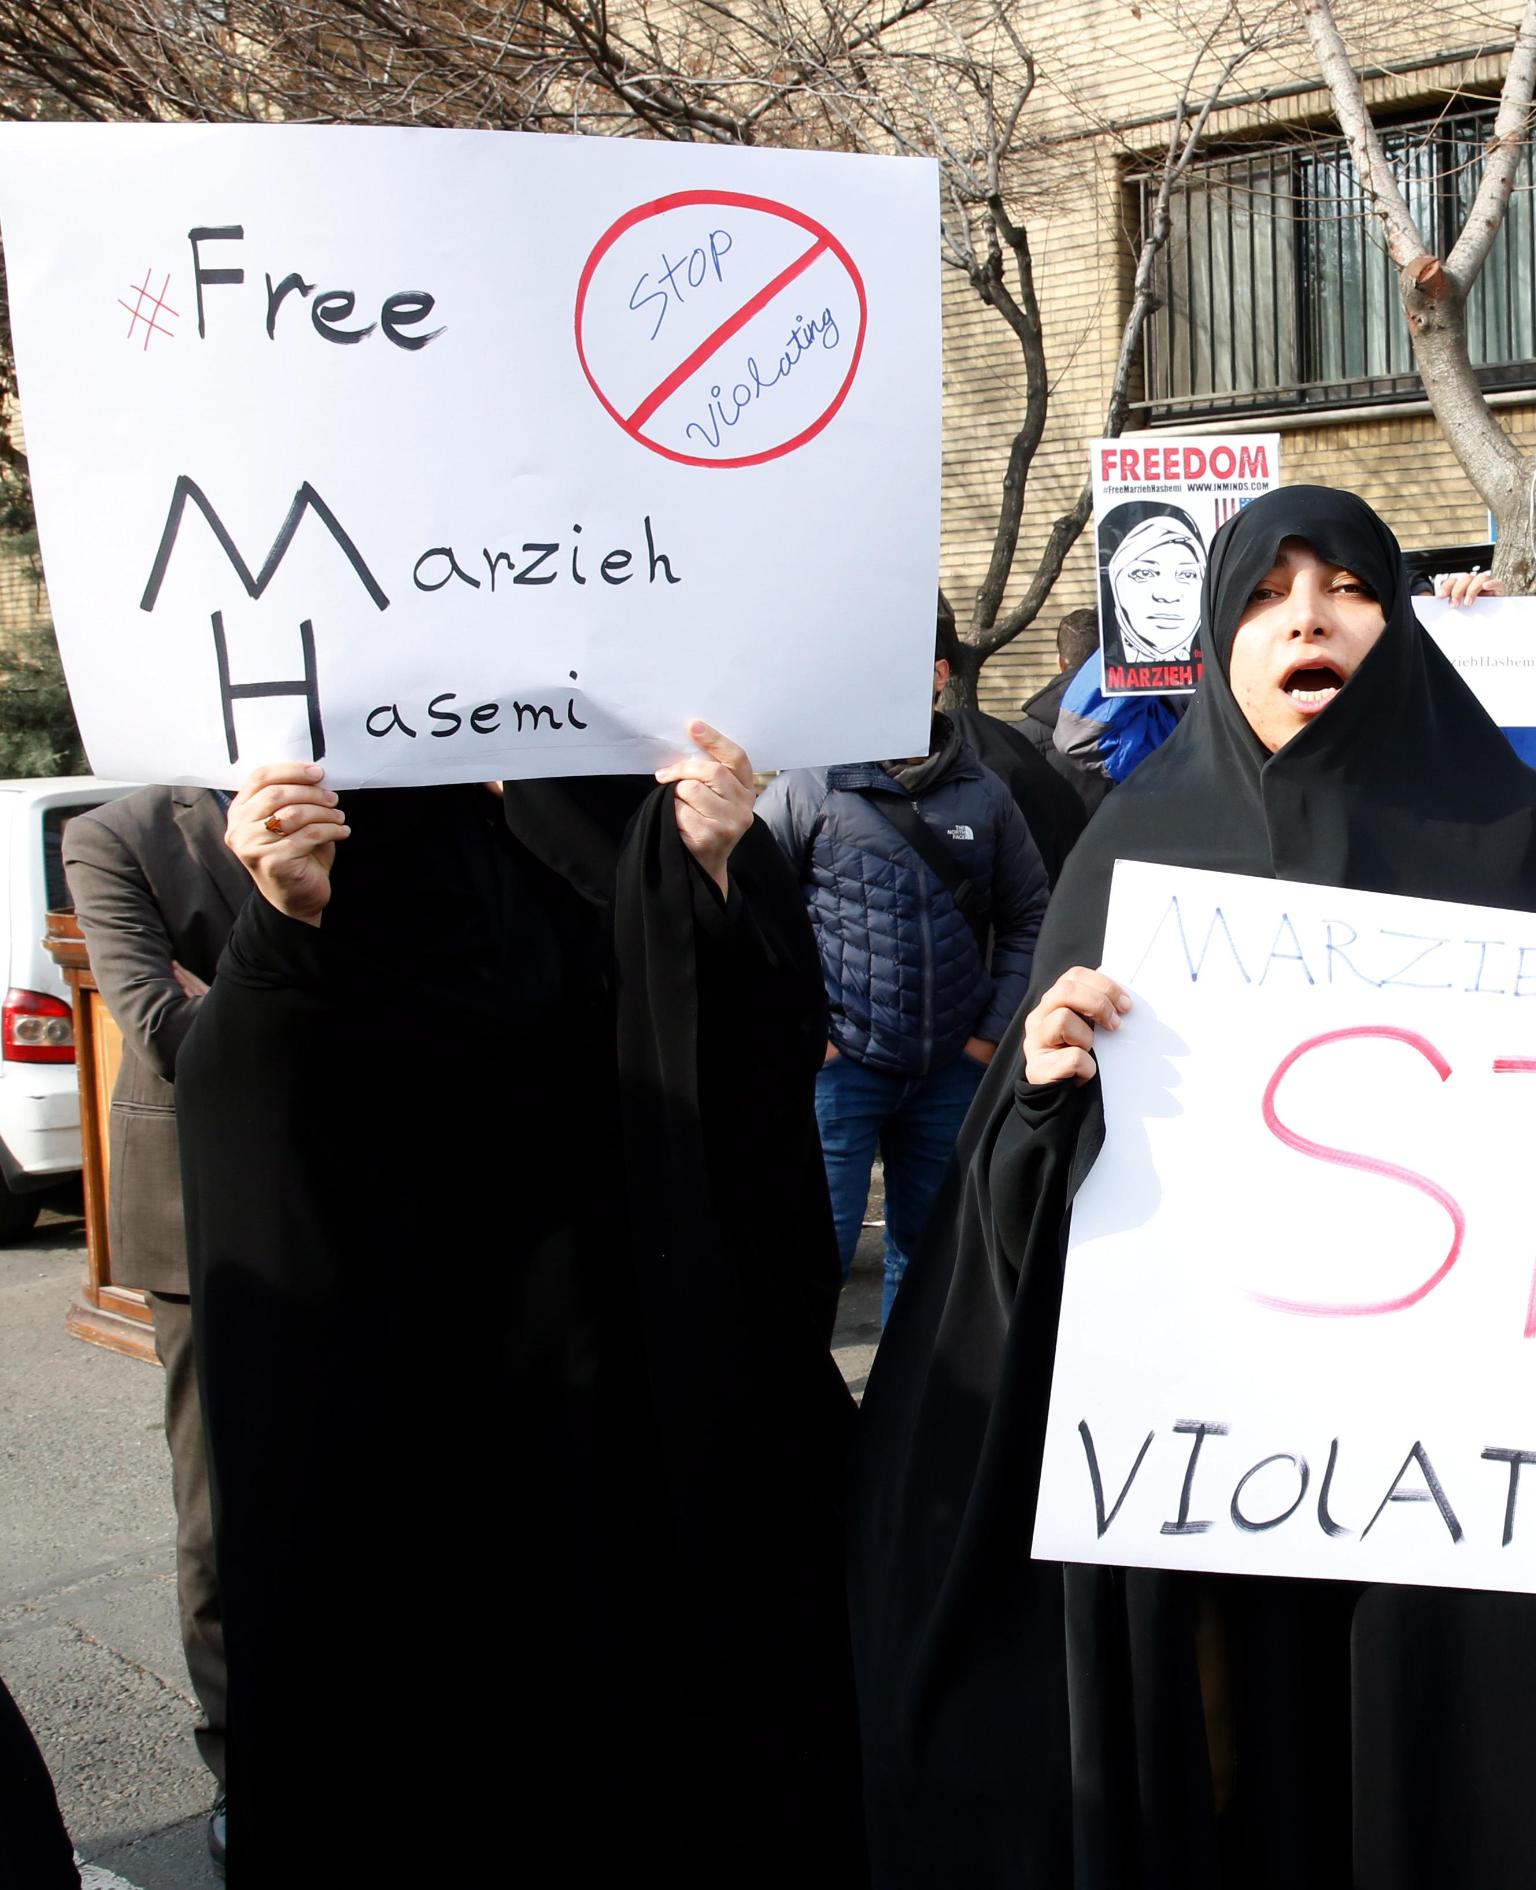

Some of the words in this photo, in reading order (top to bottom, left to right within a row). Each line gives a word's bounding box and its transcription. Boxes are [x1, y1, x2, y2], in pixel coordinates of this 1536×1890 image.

[1101, 446, 1269, 481] FREEDOM
[1187, 482, 1269, 492] WWW.INMINDS.COM
[140, 475, 682, 612] Marzieh
[211, 611, 589, 764] Hasemi
[1107, 665, 1193, 688] MARZIEH
